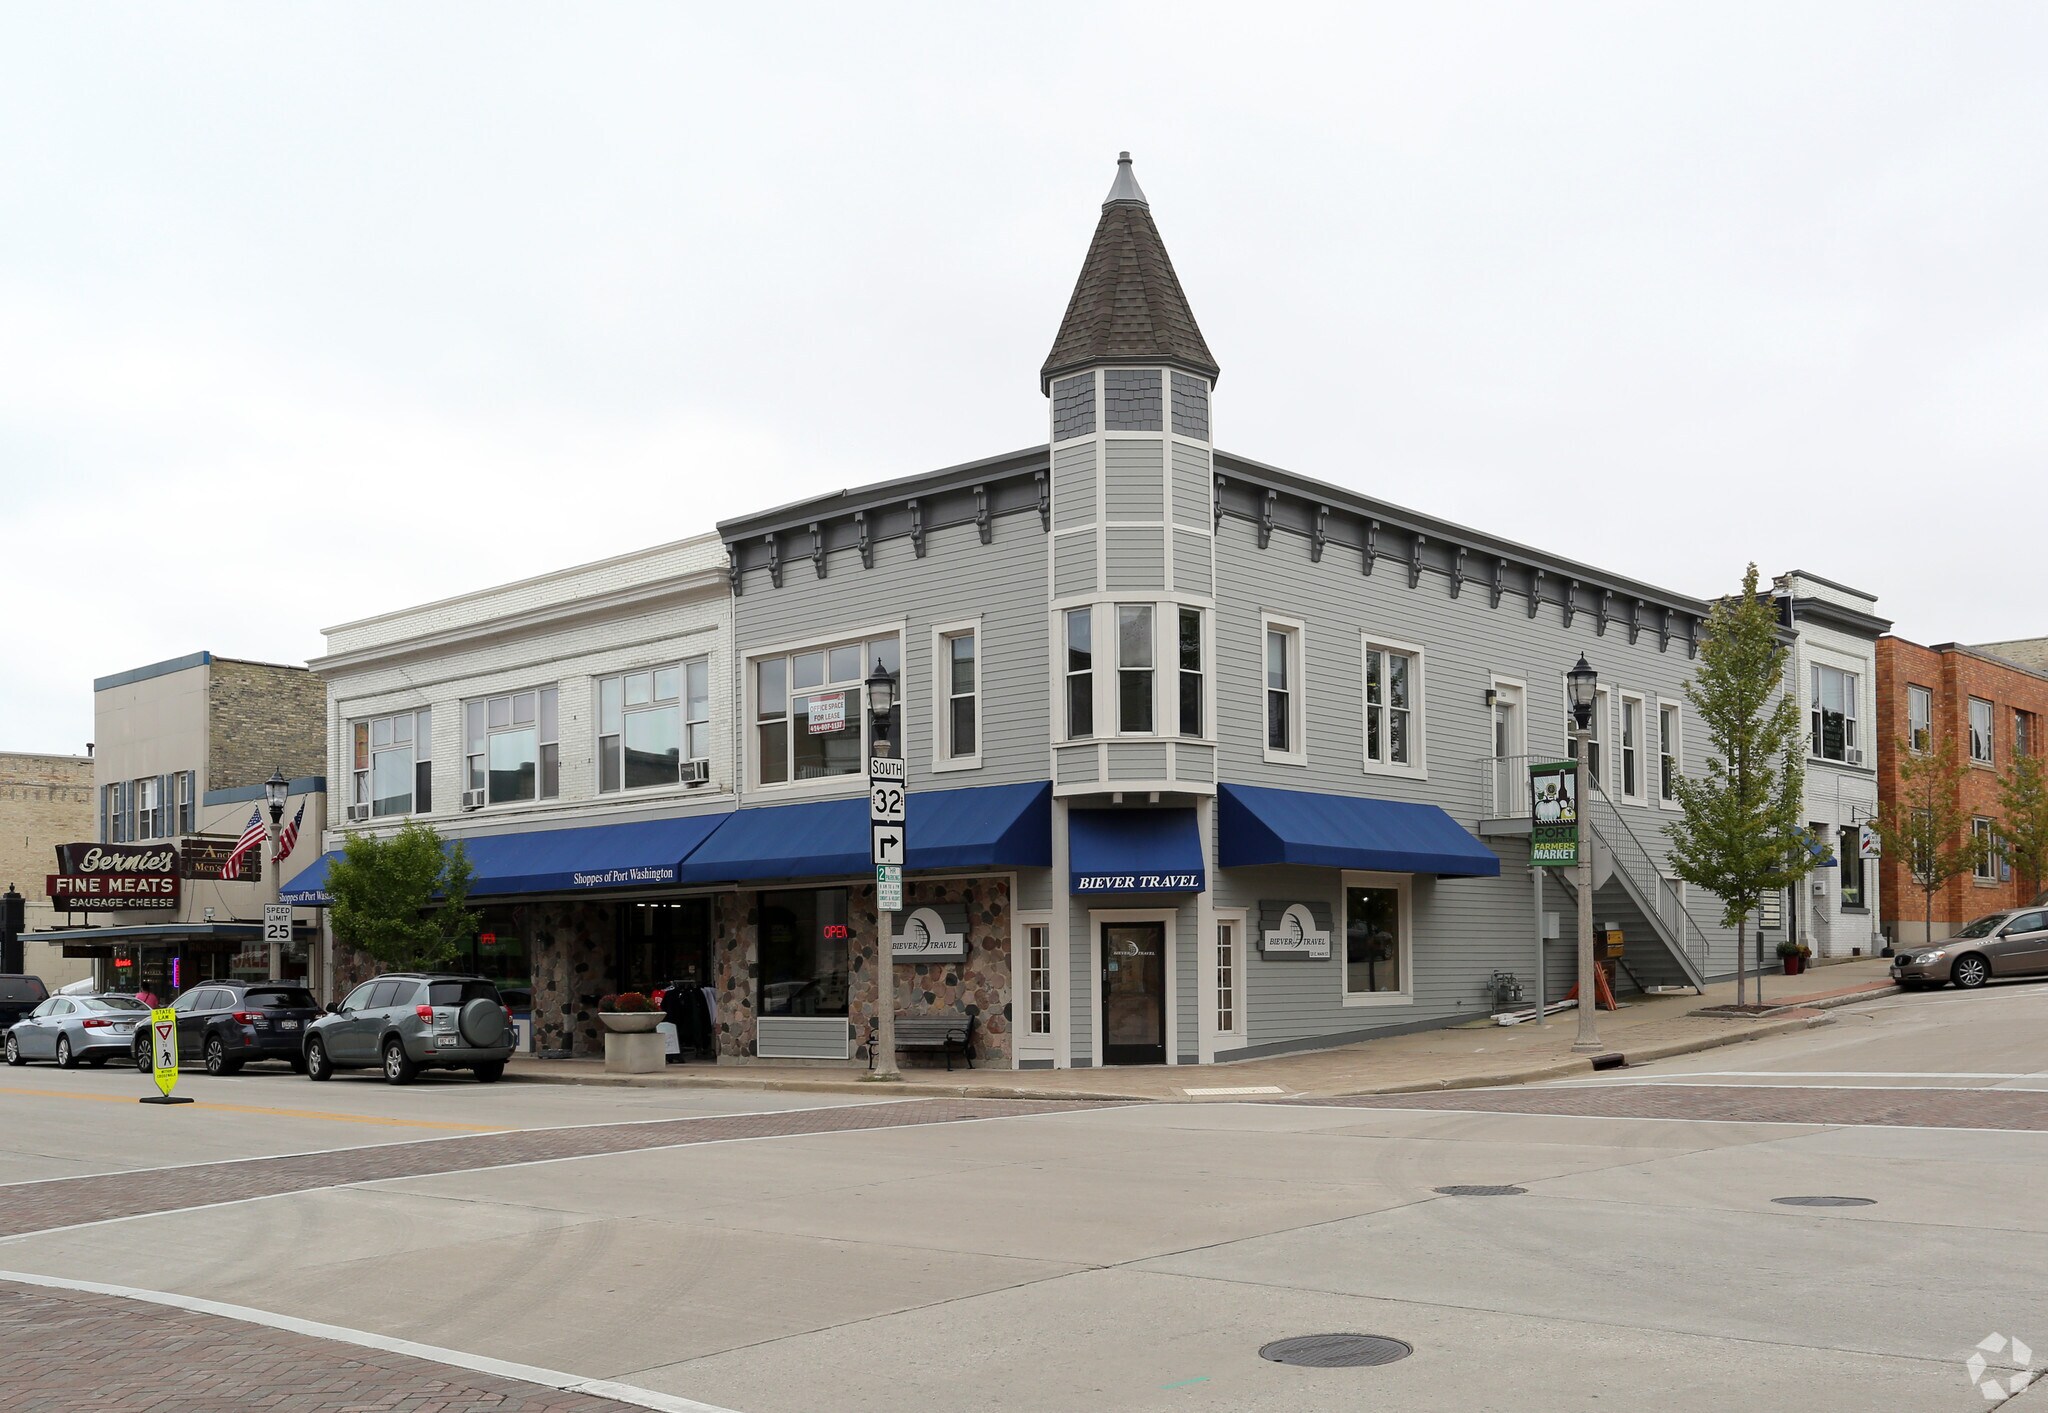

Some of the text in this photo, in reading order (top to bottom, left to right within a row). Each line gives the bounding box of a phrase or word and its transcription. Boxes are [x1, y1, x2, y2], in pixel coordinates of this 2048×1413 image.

[810, 702, 844, 712] OFFICE SPACE
[825, 712, 840, 720] LEASE
[872, 760, 902, 776] SOUTH
[875, 789, 901, 813] 32
[1535, 827, 1575, 838] PORT
[1534, 842, 1575, 850] FARMERS
[79, 847, 173, 872] Bernie's
[1533, 849, 1575, 859] MARKET
[194, 863, 221, 872] Men's
[573, 867, 673, 886] Shoppes of Port Washington
[879, 868, 885, 880] 2
[56, 878, 173, 893] FINE MEATS
[1078, 875, 1199, 889] BIEVER TRAVEL
[299, 891, 305, 901] of
[305, 891, 316, 901] Port
[69, 898, 174, 907] SAUSAGE-CHEESE
[267, 925, 289, 939] 25
[823, 926, 848, 938] OPEN
[891, 941, 957, 950] BIEVER TRAVEL
